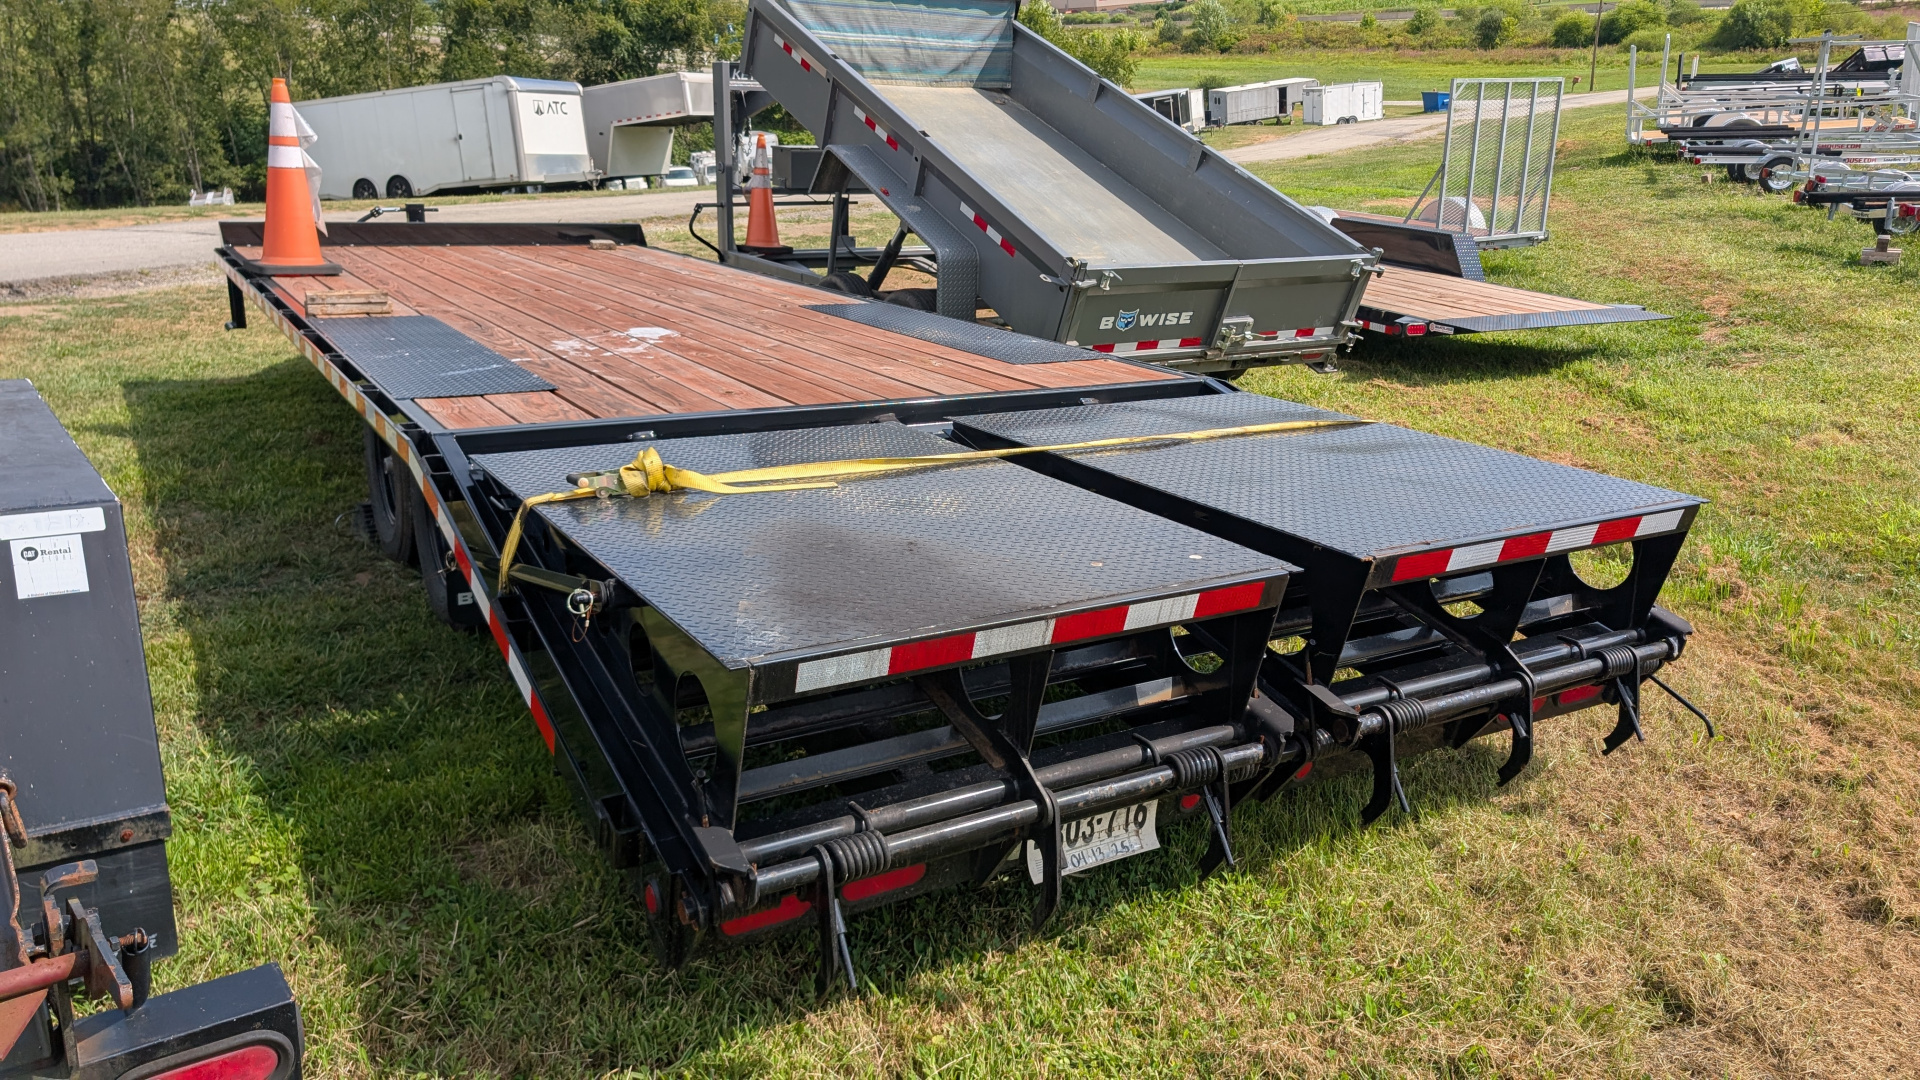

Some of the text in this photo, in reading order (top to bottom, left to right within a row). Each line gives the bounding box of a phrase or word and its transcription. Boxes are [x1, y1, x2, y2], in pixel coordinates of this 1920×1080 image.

[732, 68, 753, 80] KE
[547, 101, 568, 115] ATC
[1140, 311, 1193, 327] WISE
[40, 547, 71, 556] Rental
[1070, 850, 1088, 868] 04
